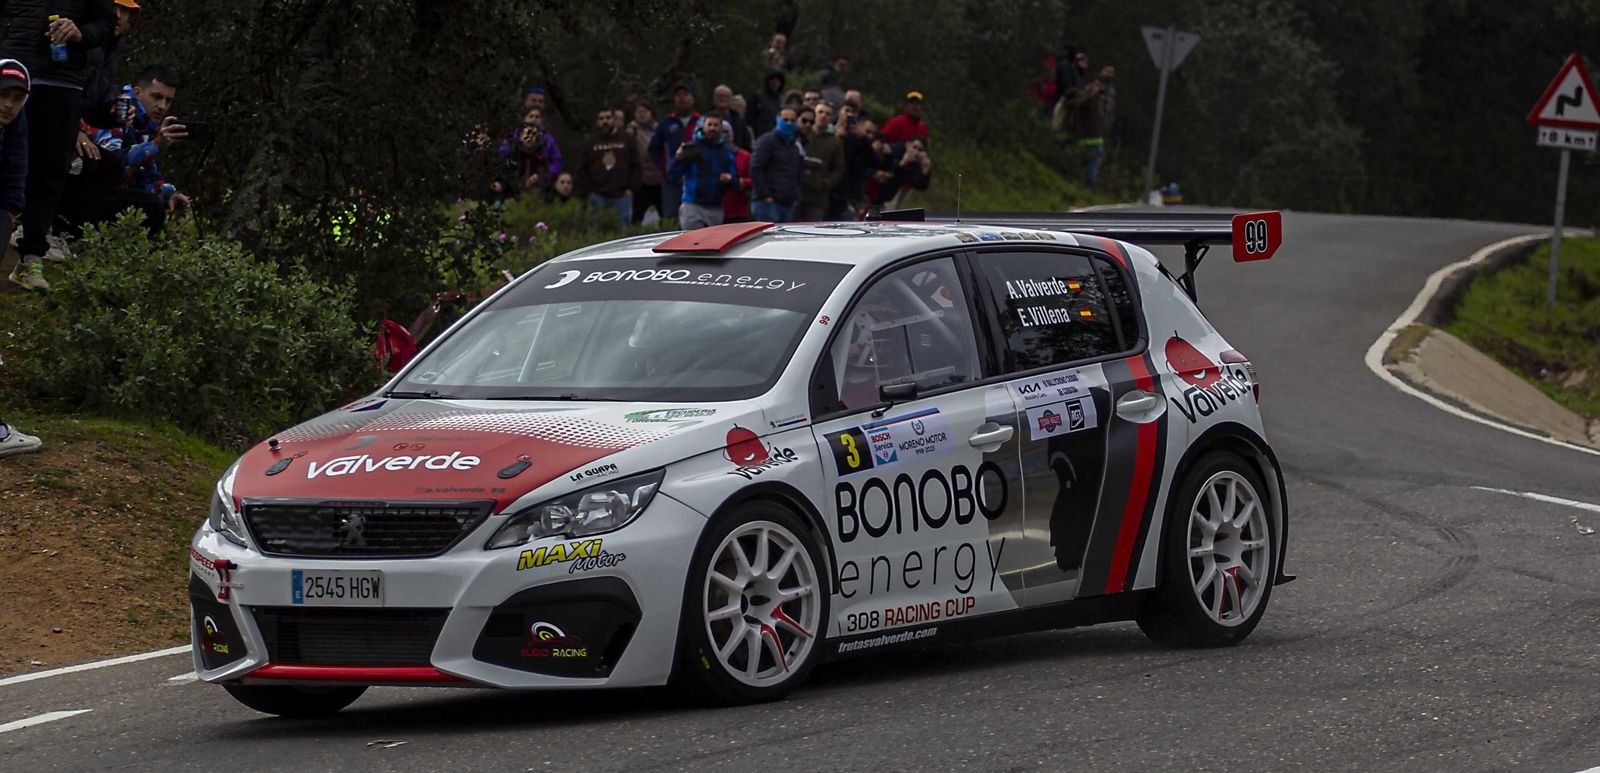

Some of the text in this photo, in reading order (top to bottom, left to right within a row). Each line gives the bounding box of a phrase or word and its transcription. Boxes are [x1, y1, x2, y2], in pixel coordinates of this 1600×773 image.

[1565, 133, 1586, 145] km
[1245, 218, 1269, 255] 99
[582, 269, 807, 292] BONOBO energy
[1006, 277, 1067, 300] A.Valverde
[819, 315, 831, 326] 99
[1020, 305, 1071, 327] E.Villena
[1018, 383, 1041, 395] KIA
[1170, 367, 1252, 425] Valverde
[871, 431, 892, 444] BOSCH
[874, 441, 894, 452] Service
[898, 432, 948, 451] MORENO MOTOR
[840, 432, 861, 468] 3
[570, 463, 618, 482] LA GUAPA
[834, 460, 1009, 543] BONOBO
[569, 549, 626, 574] Motor
[838, 536, 1006, 599] energy
[305, 576, 381, 599] 2545 HGW
[847, 595, 977, 632] 308 RACING CUP
[838, 627, 937, 653] frutasvalverde.com
[519, 647, 588, 657] AUDIO RACING
